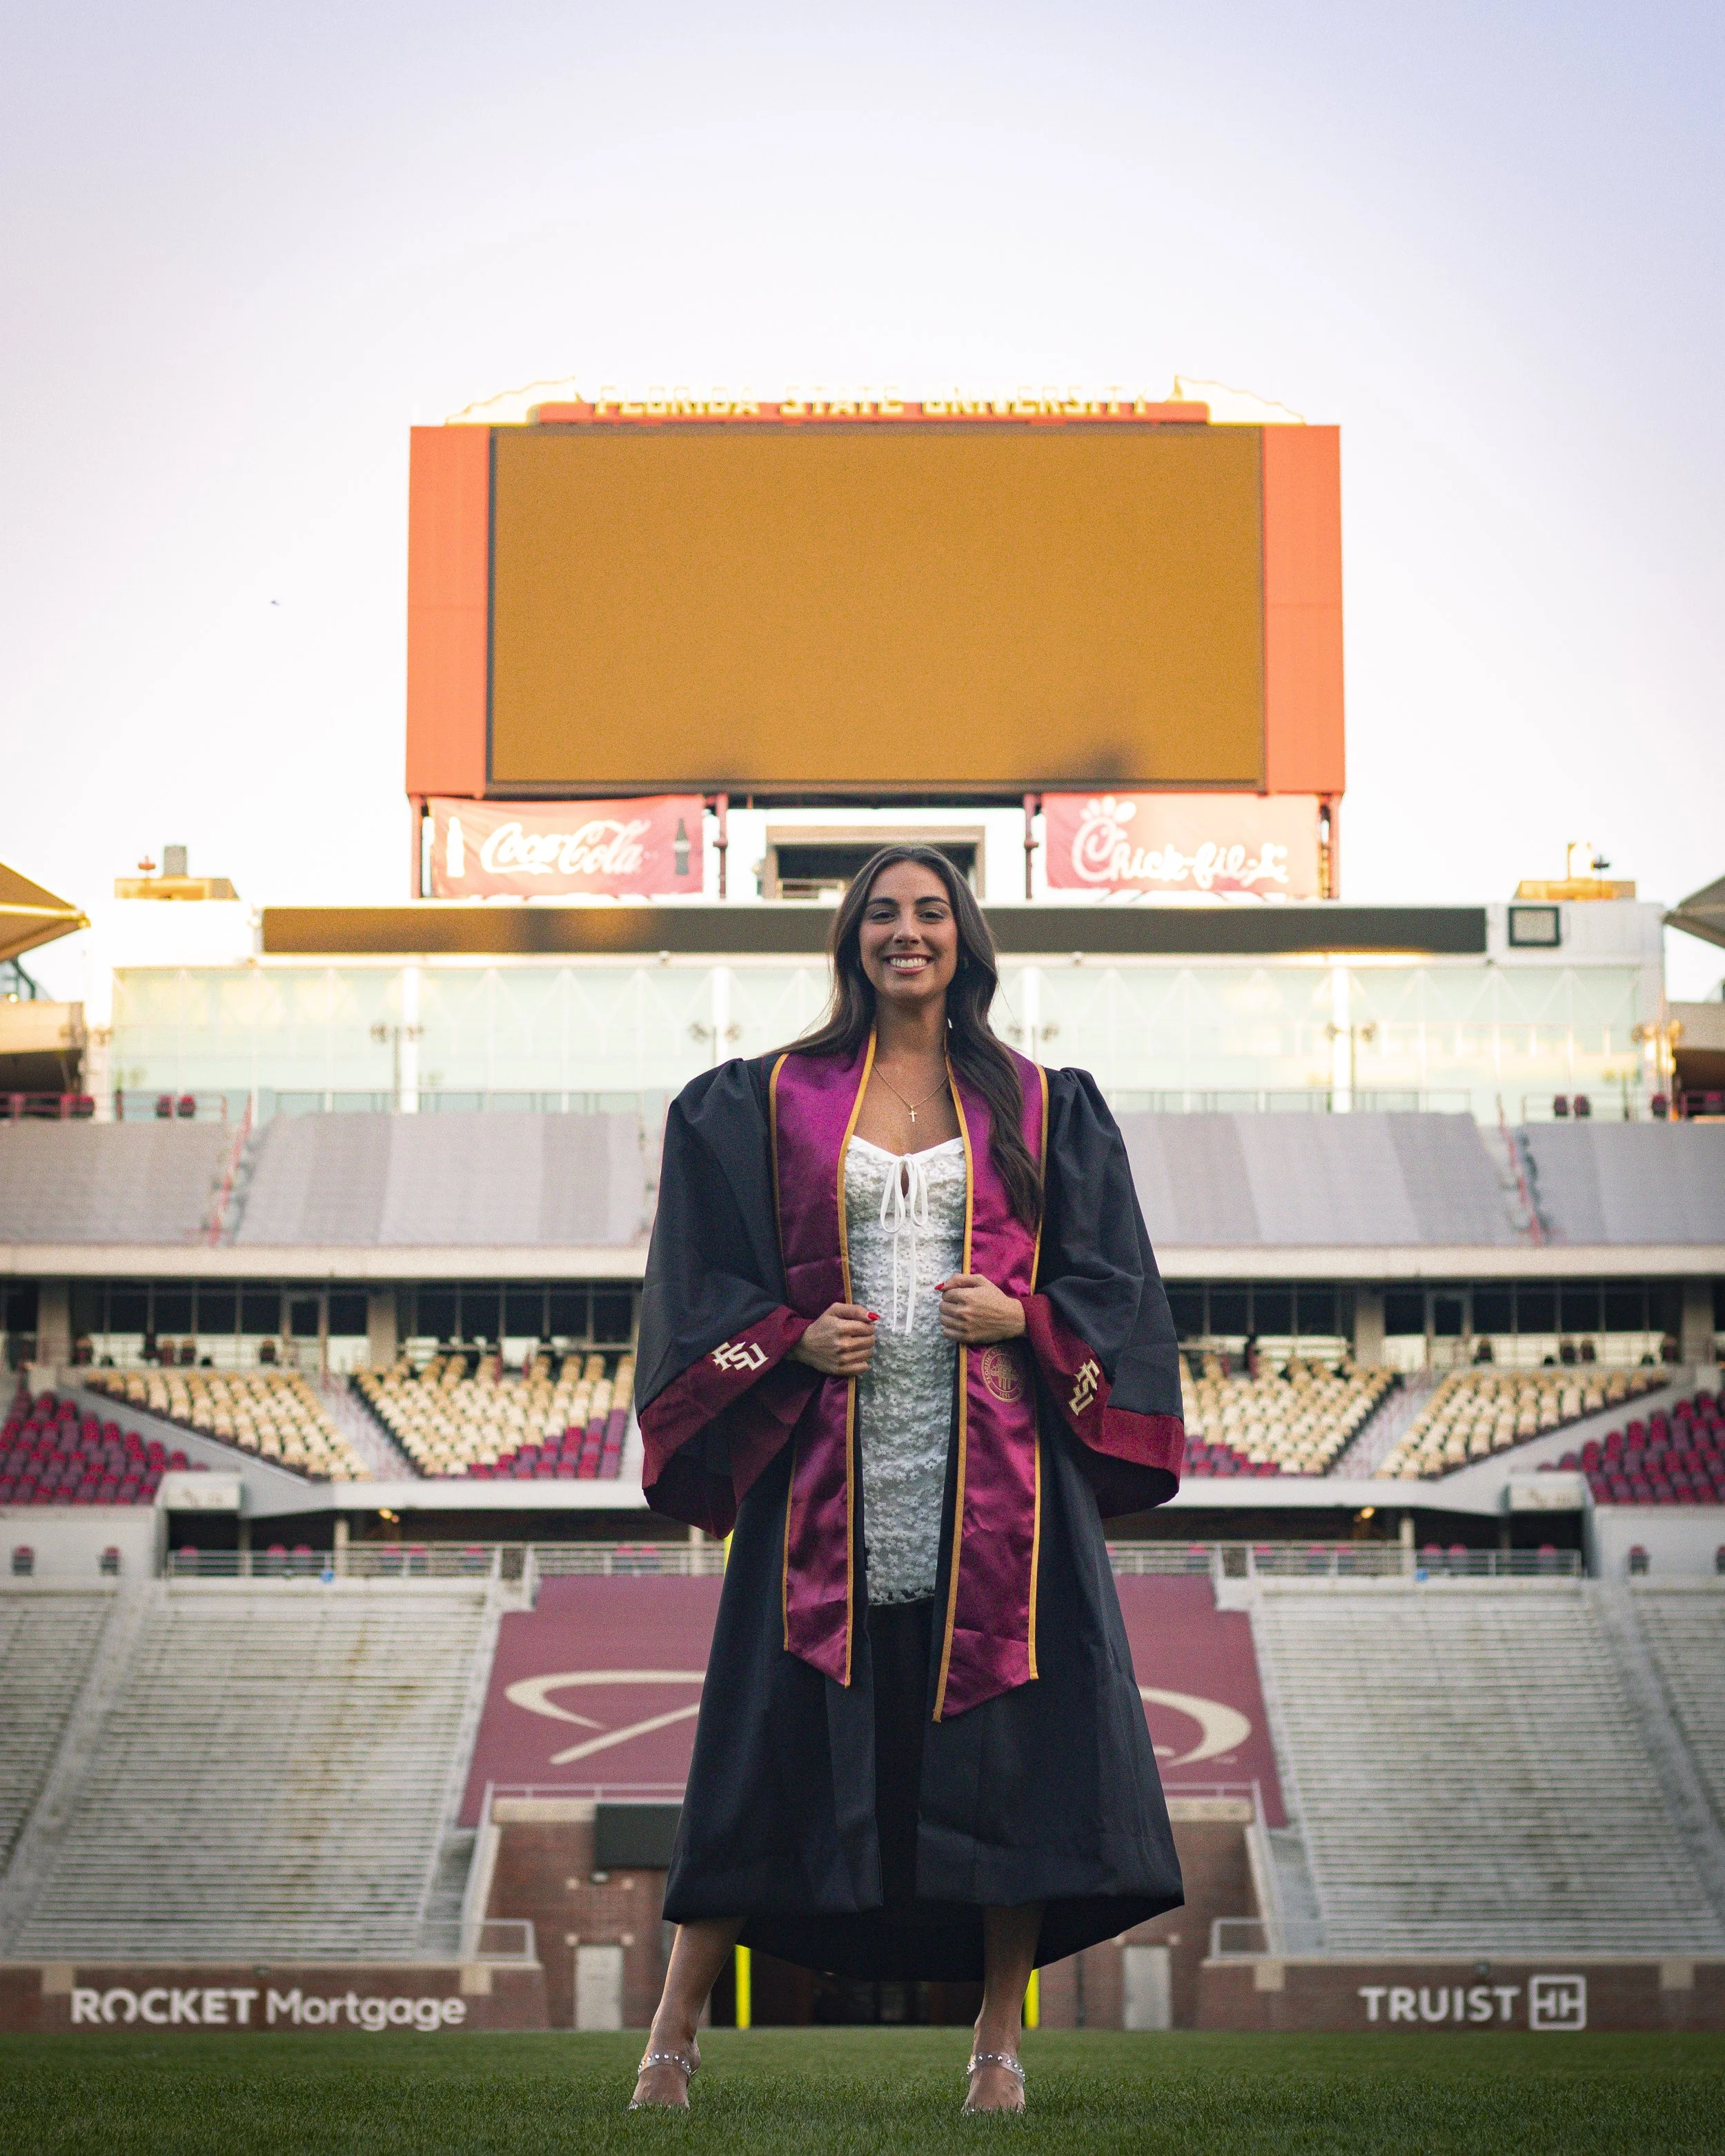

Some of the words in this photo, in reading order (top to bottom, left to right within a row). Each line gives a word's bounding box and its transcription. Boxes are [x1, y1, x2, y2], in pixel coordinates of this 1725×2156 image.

[595, 385, 759, 415] FLORIDA
[778, 385, 903, 415] STATE
[922, 385, 1148, 415] UNIVERSITY
[711, 1341, 769, 1372] FSU
[1069, 1358, 1101, 1416] FSU
[70, 1987, 259, 2024] ROCKET
[266, 1988, 467, 2032] Mortgage
[1359, 1986, 1520, 2021] TRUIST
